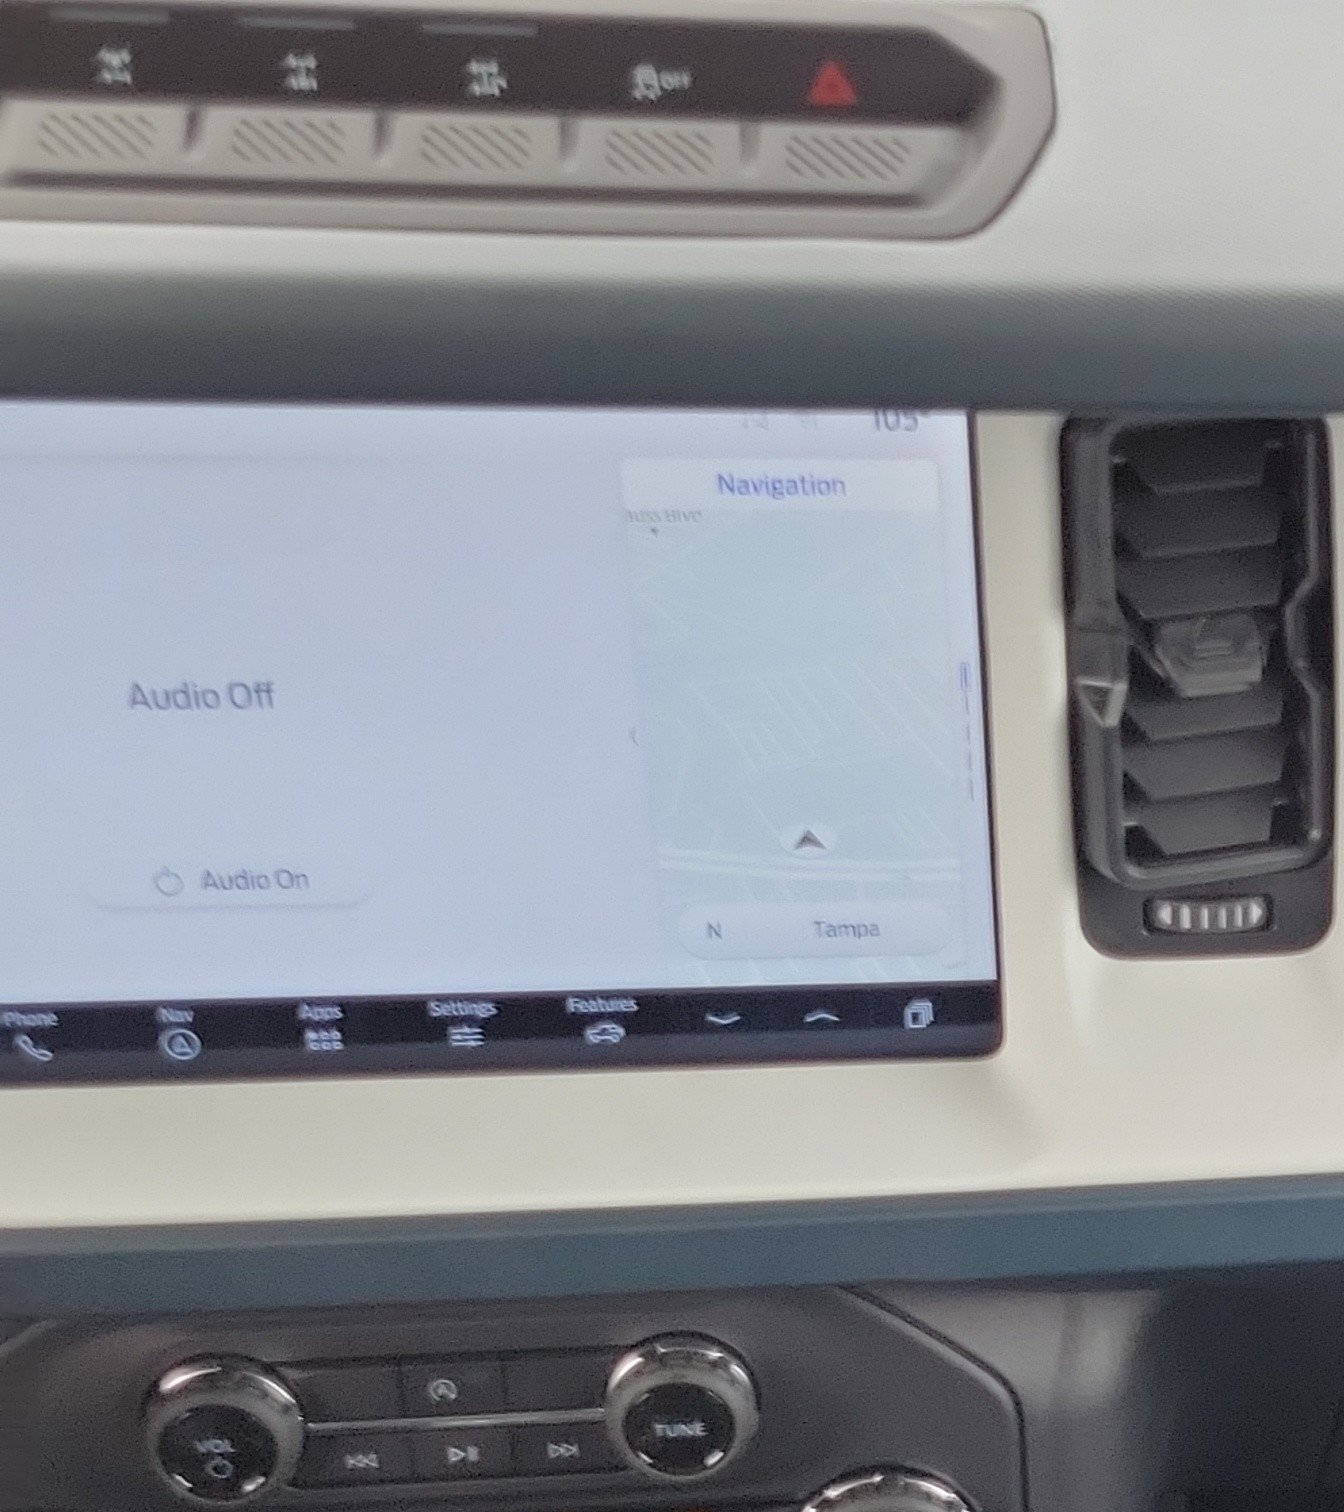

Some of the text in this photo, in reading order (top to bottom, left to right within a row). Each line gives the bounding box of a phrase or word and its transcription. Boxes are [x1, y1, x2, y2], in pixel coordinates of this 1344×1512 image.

[716, 472, 847, 499] Navigation
[128, 680, 275, 711] Audio Off
[200, 868, 309, 892] Audio On
[707, 922, 722, 940] N
[813, 921, 881, 940] Tampa
[300, 1003, 344, 1021] Apps
[428, 1000, 498, 1018] Settings
[566, 997, 639, 1013] Features
[2, 1011, 58, 1027] Phone
[158, 1006, 194, 1023] Nav
[654, 1421, 709, 1437] TUNE
